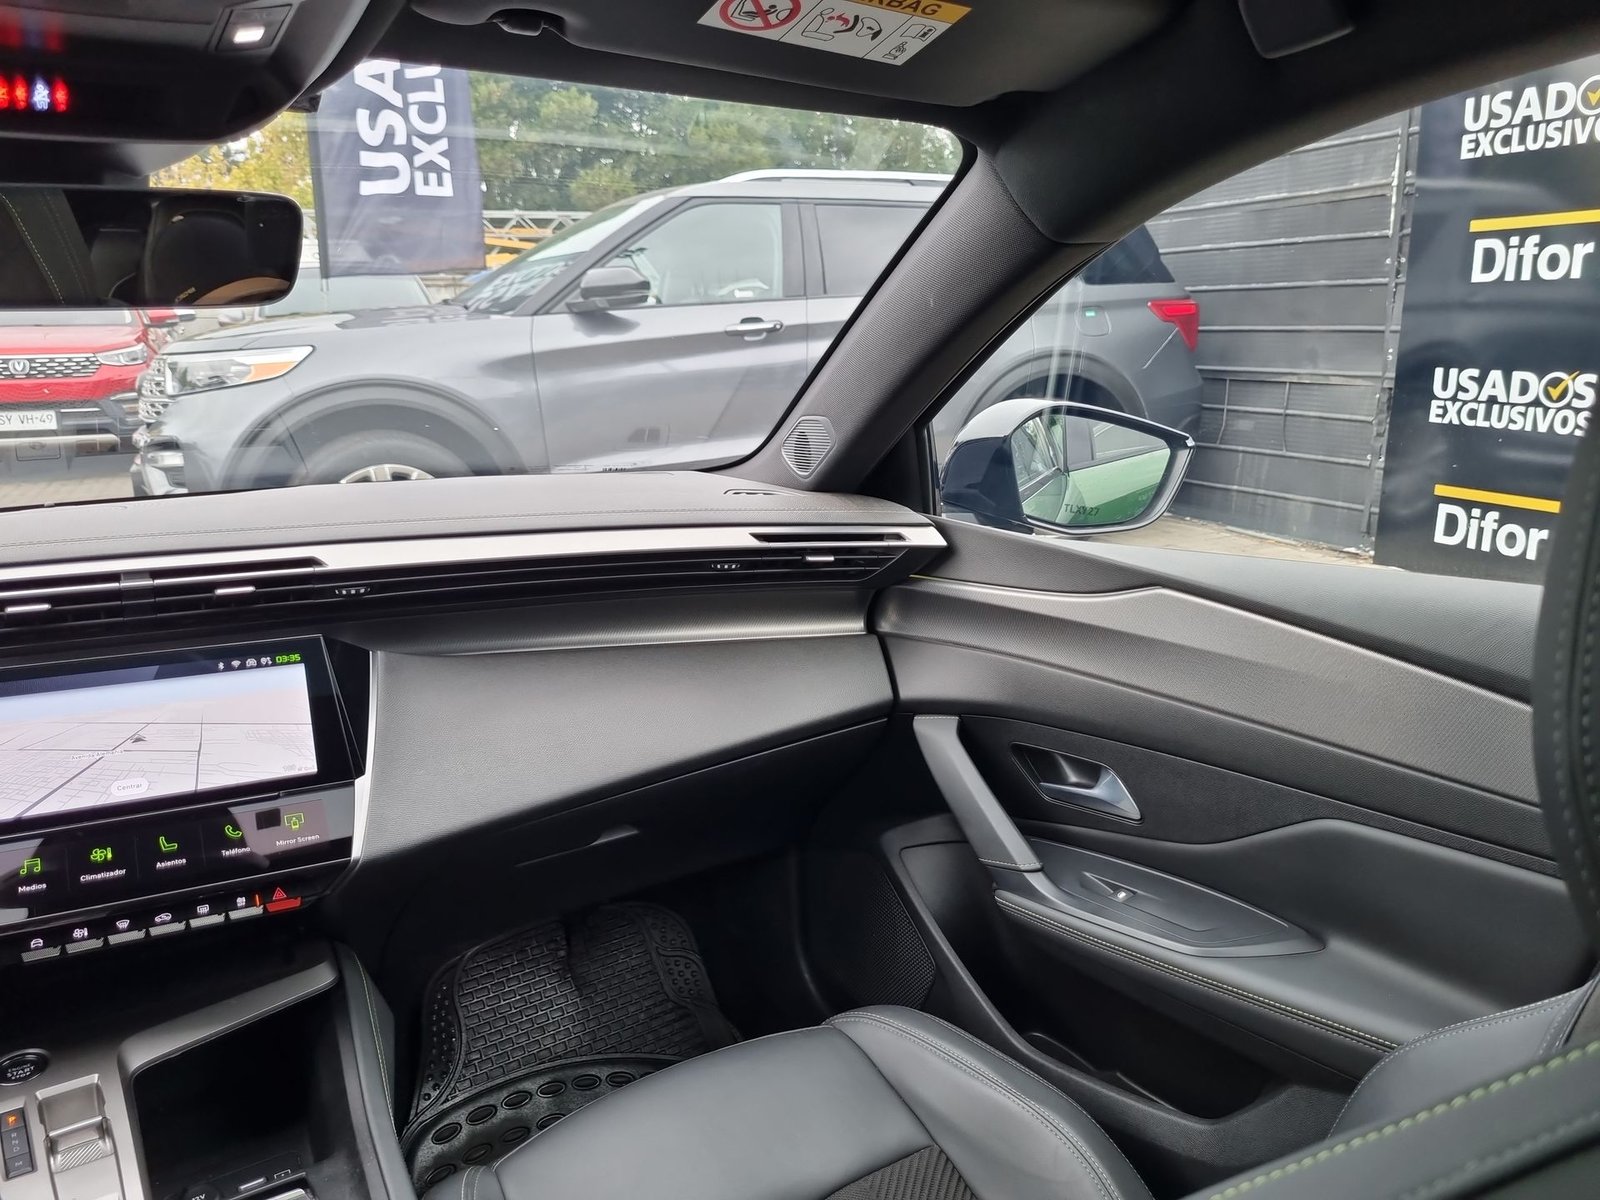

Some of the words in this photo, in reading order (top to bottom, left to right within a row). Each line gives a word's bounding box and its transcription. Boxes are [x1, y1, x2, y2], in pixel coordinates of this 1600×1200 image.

[353, 60, 411, 196] USA
[1460, 115, 1600, 160] EXCLUSIV
[1471, 234, 1595, 283] Difor
[1433, 367, 1598, 408] USADOS
[1429, 400, 1592, 437] EXCLUSIVOS
[1433, 503, 1549, 560] Difor
[275, 653, 301, 664] 03:35
[276, 839, 297, 847] Mirror
[297, 834, 320, 843] Screen
[221, 847, 250, 857] Teléfono
[156, 858, 187, 869] Asientos
[80, 869, 126, 882] Climatizador
[18, 883, 47, 893] Medios
[6, 1066, 35, 1078] START
